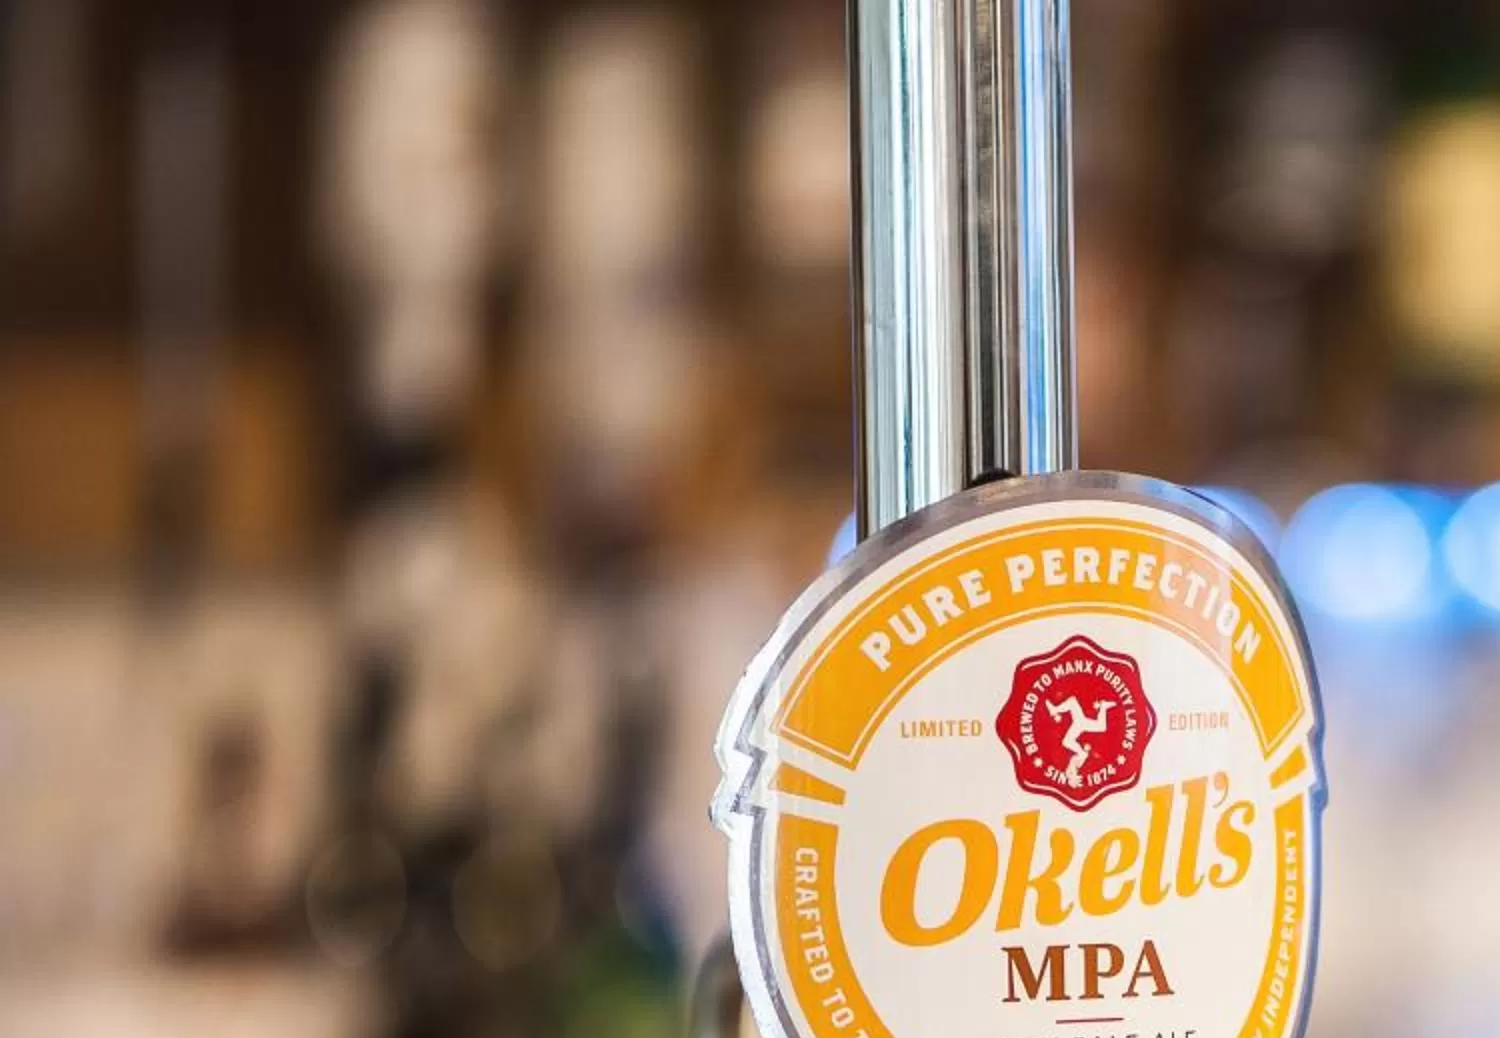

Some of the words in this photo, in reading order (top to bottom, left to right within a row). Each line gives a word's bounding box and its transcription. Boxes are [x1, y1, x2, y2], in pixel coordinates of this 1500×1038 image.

[859, 569, 993, 672] PURE
[1004, 546, 1262, 666] PERFECTION
[899, 719, 982, 739] LIMITED
[1167, 711, 1230, 731] EDITION
[1020, 693, 1039, 755] BREWED
[1033, 673, 1053, 692] TO
[1052, 660, 1093, 680] MANX
[1096, 664, 1133, 708] PURITY
[1123, 709, 1136, 751] LAWS
[1087, 765, 1116, 785] 1874
[879, 770, 1256, 948] Okell's
[795, 847, 834, 983] CRAFTED
[822, 988, 855, 1029] TO
[1263, 829, 1298, 1028] INDEPENDENT
[1001, 939, 1175, 1003] MPA
